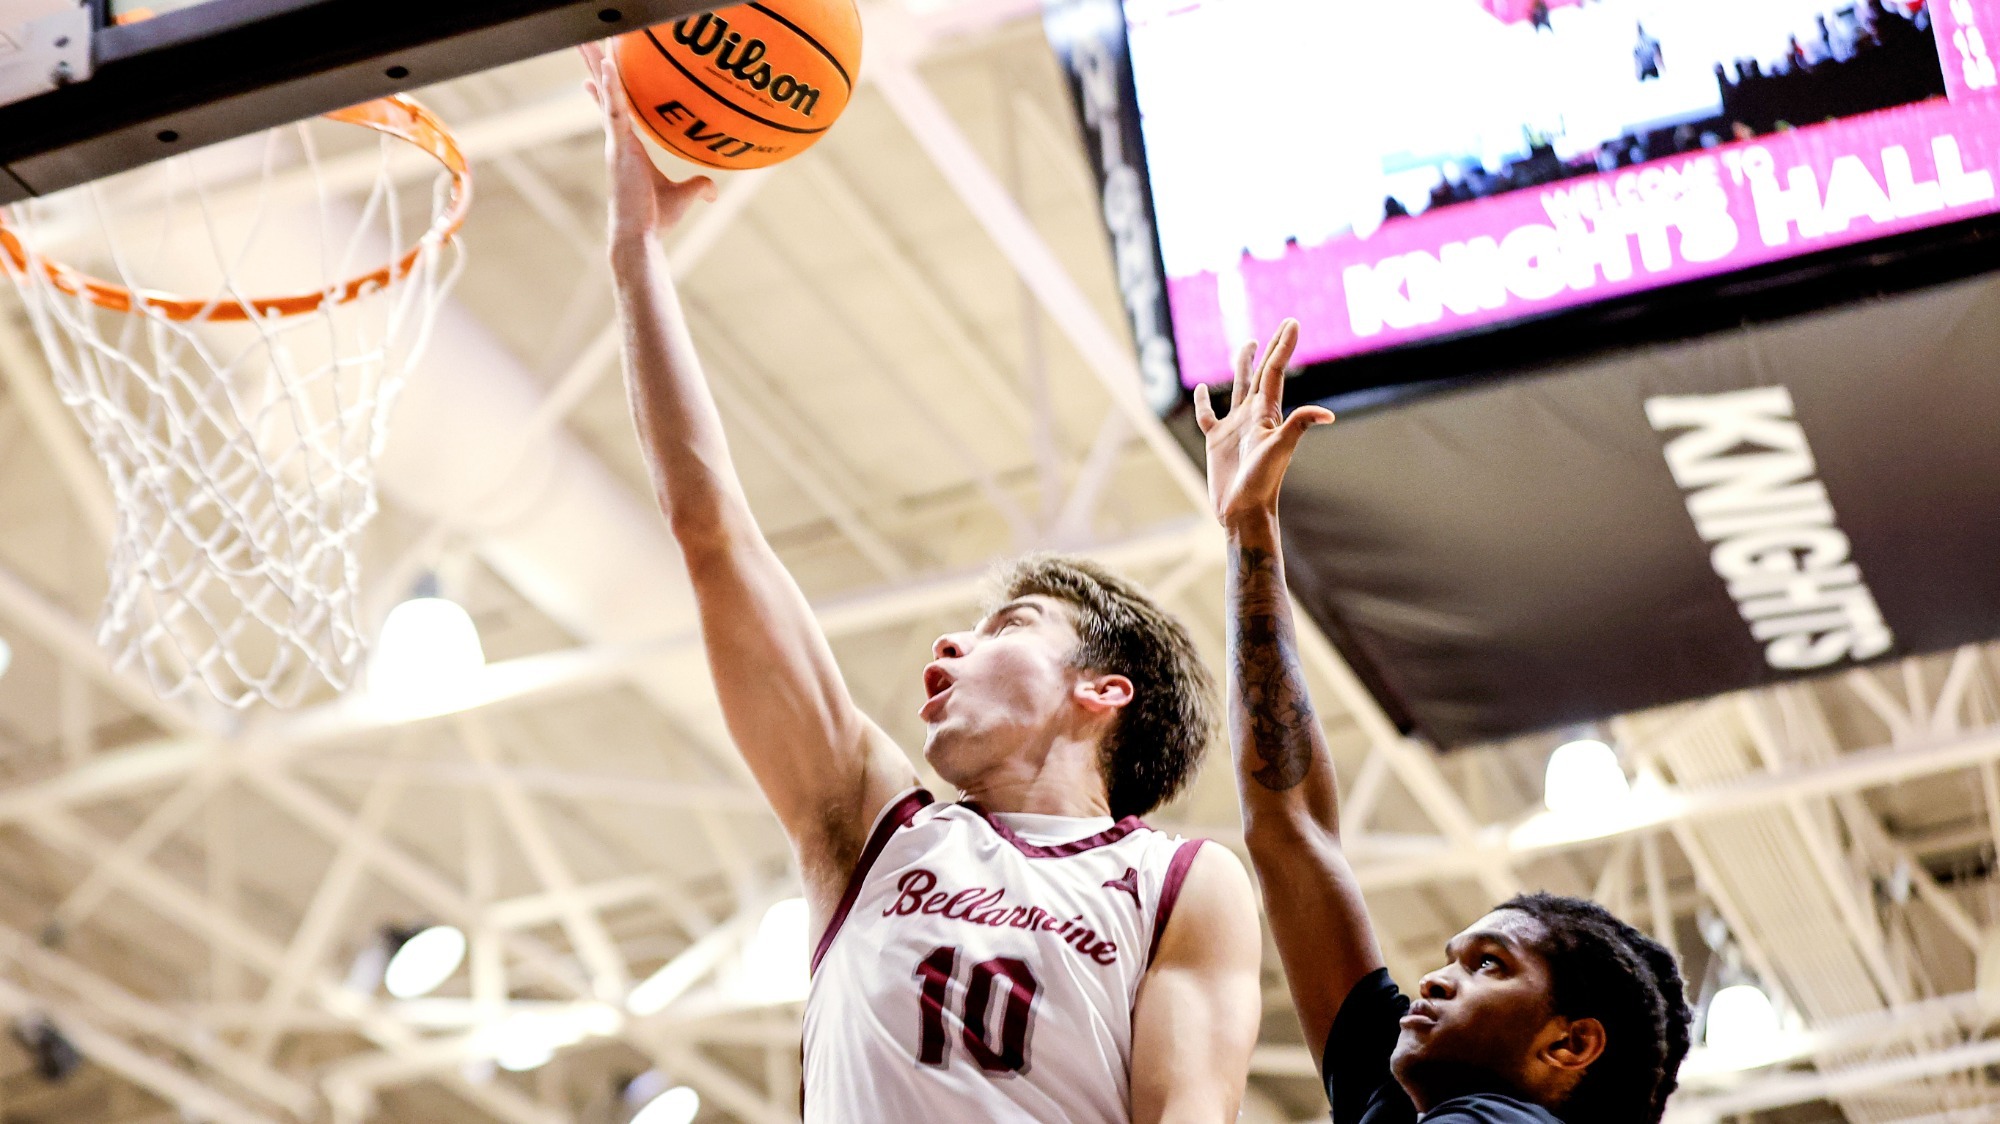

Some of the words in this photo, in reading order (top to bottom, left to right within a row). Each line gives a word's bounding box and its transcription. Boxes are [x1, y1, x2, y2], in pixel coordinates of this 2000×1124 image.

[673, 11, 821, 118] Wilson
[654, 100, 755, 158] EVO
[1342, 187, 1740, 338] KNIGHTS
[1750, 134, 1995, 247] HALL
[1540, 155, 1720, 222] WELCOME
[1721, 145, 1775, 187] TO
[1644, 384, 1894, 670] KNIGHTS
[881, 869, 1118, 966] Bellarmine
[911, 946, 1046, 1079] 10
